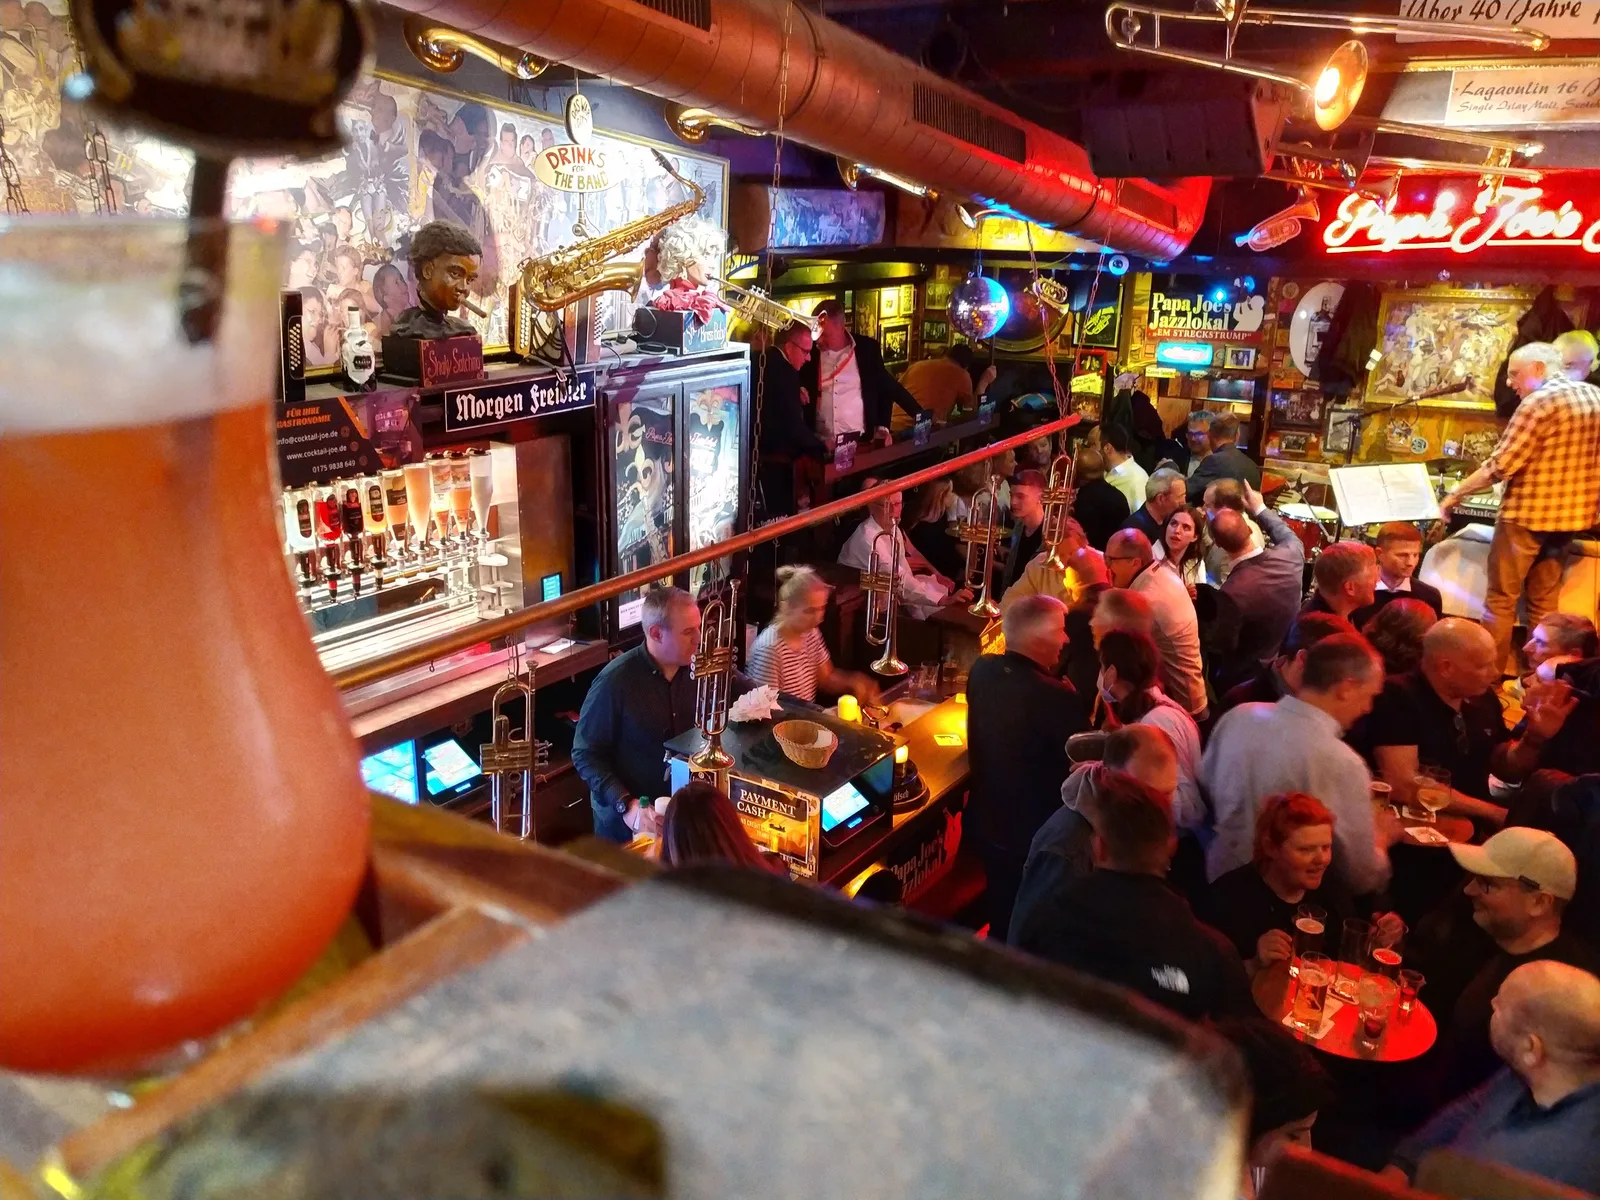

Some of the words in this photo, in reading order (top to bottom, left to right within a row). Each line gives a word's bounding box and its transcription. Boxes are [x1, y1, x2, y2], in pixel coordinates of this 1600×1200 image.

[1469, 0, 1501, 20] 40
[1505, 0, 1582, 25] Jahre
[1460, 80, 1548, 100] Lagavulin
[1557, 80, 1580, 94] 16
[1457, 101, 1493, 113] Single
[1496, 100, 1528, 112] Islay
[545, 146, 606, 170] DRINKS
[572, 165, 585, 173] FOR
[554, 170, 574, 189] THE
[577, 171, 609, 190] BAND
[1323, 188, 1453, 253] Papa
[1449, 186, 1584, 253] Joe's
[1151, 292, 1192, 317] Papa
[1192, 294, 1232, 315] Joes
[1149, 310, 1230, 331] Jazzlokal
[456, 392, 523, 421] Morgen
[530, 380, 587, 415] Freiier
[276, 414, 331, 429] GASTRONOMIE
[286, 408, 302, 418] FÜR
[302, 406, 320, 416] IHRE
[276, 430, 338, 446] info@cocktail-joe.de
[286, 445, 347, 461] www.cocktail-joe.de
[312, 464, 328, 474] 0175
[329, 461, 344, 472] 9838
[344, 460, 356, 470] 649
[740, 788, 797, 817] PAYMENT
[893, 789, 909, 802] ölsch
[736, 801, 767, 819] CASH
[901, 847, 942, 900] zzlokal
